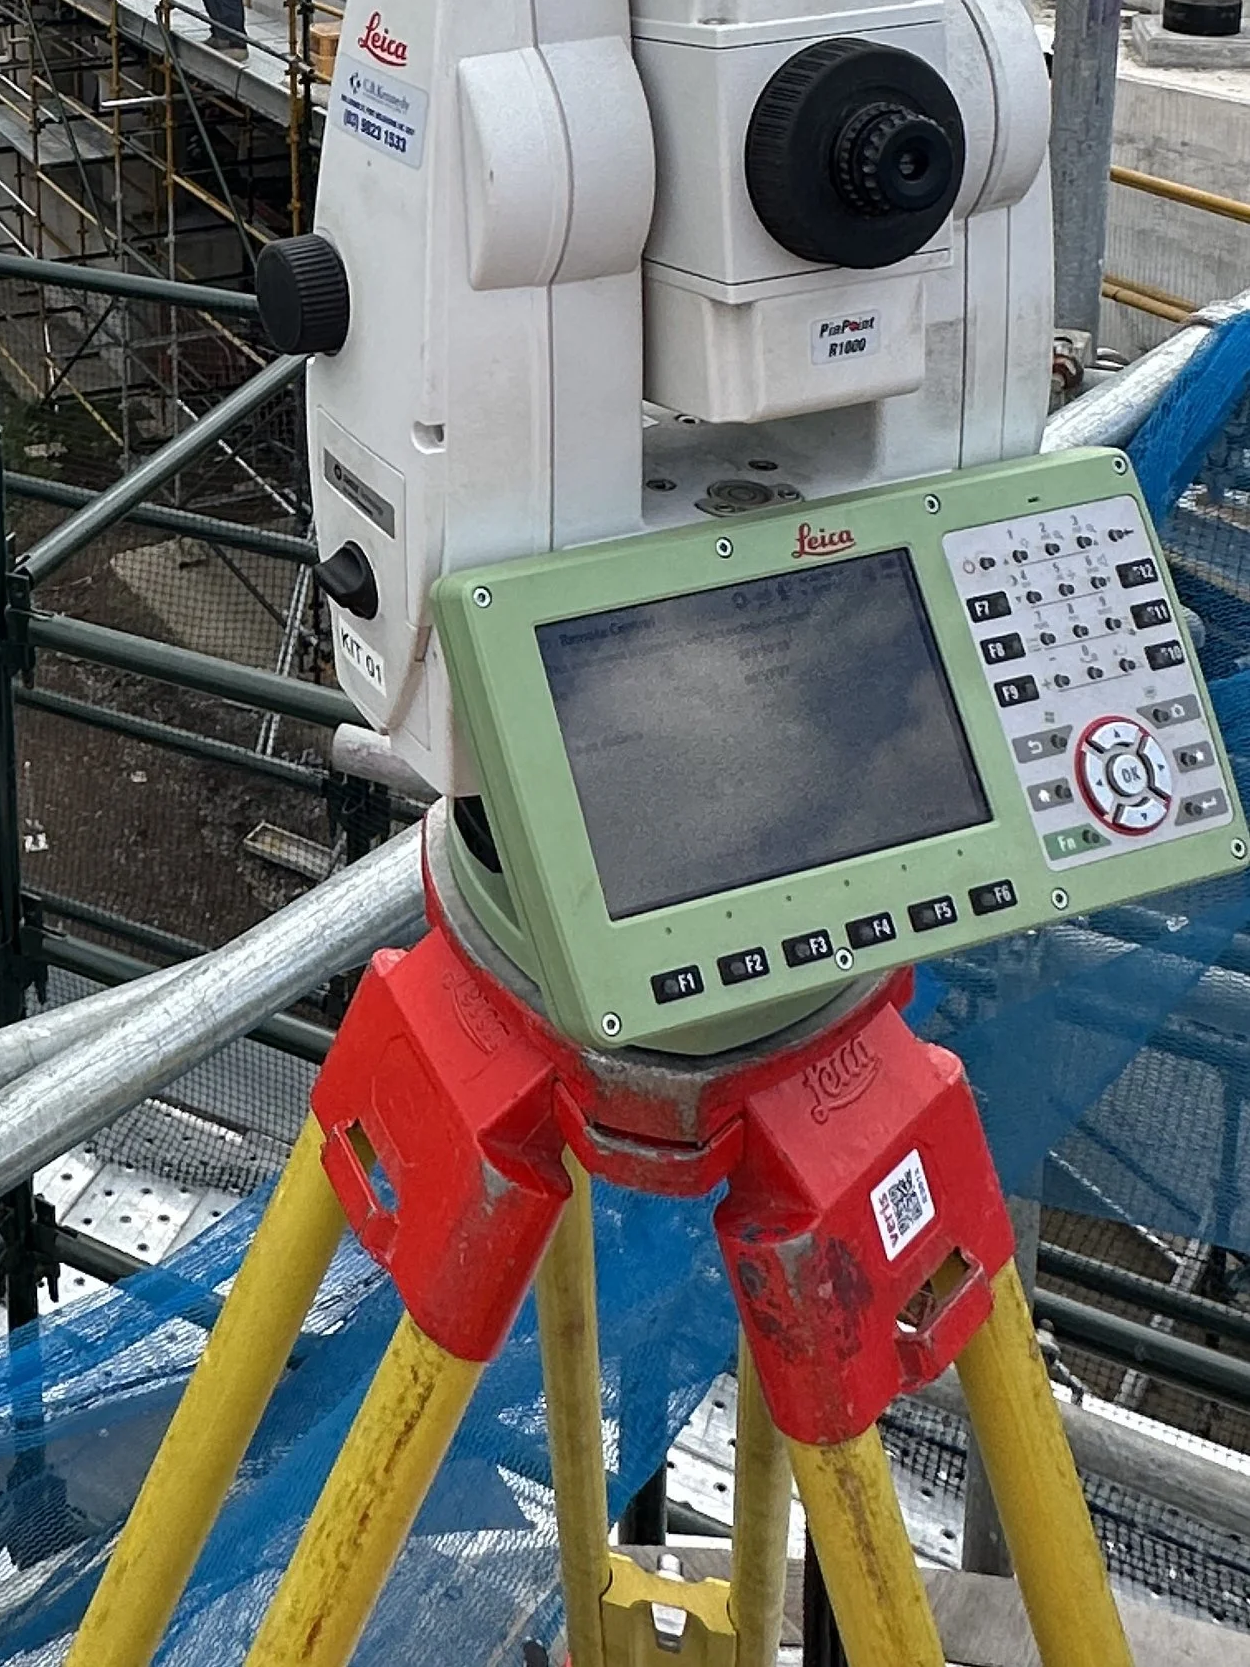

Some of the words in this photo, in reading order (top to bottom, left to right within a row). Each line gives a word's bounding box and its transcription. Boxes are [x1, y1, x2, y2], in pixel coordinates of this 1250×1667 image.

[358, 11, 407, 66] Leica
[828, 337, 866, 357] R1000
[791, 522, 857, 559] Leica
[974, 600, 990, 617] F7
[341, 627, 363, 665] KIT
[366, 654, 382, 686] 01
[987, 642, 1006, 660] F8
[1001, 684, 1019, 702] F9
[1121, 765, 1142, 784] OK
[1056, 835, 1077, 852] Fn
[993, 885, 1012, 904] F6
[933, 901, 953, 921] F5
[872, 918, 892, 938] F4
[808, 936, 828, 956] F3
[744, 954, 764, 974] F2
[677, 972, 696, 993] F1
[802, 1033, 882, 1125] Leica
